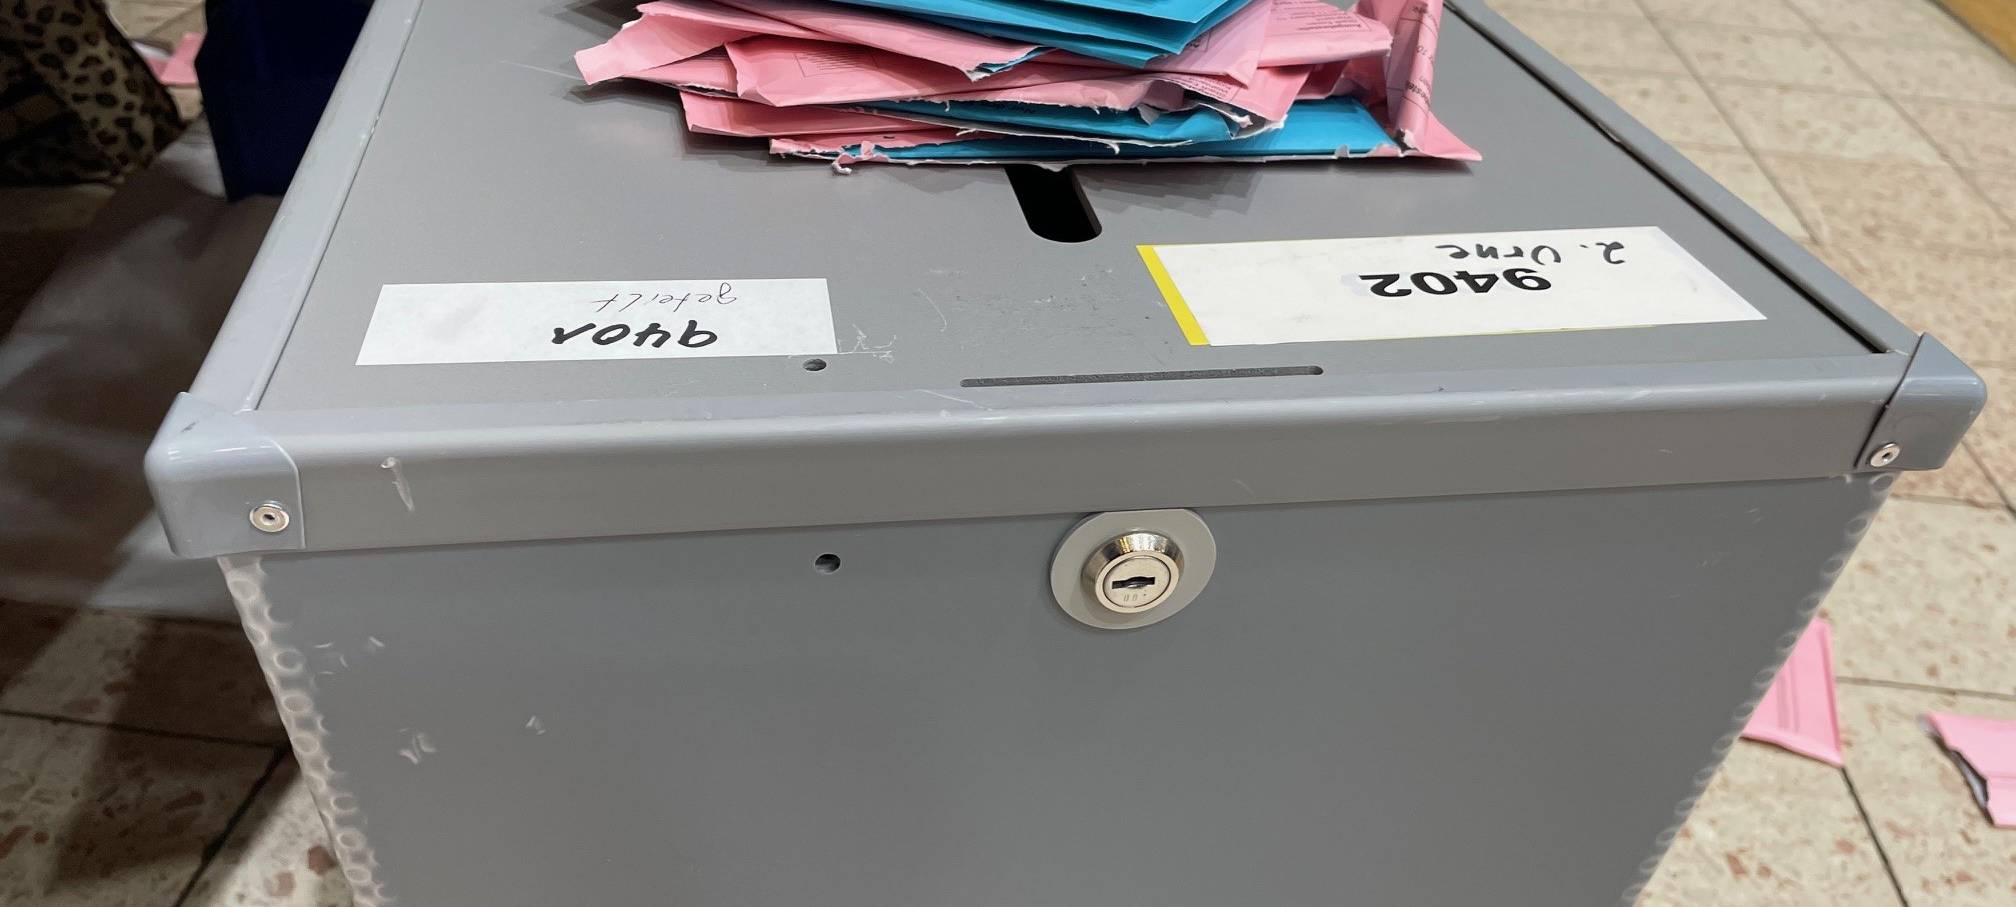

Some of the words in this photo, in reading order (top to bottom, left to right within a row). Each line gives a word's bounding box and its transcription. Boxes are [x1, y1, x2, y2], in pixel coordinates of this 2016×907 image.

[1433, 243, 1562, 266] Urne
[1579, 241, 1626, 265] 2.
[591, 281, 737, 313] geteilt
[1359, 267, 1552, 298] 9402
[551, 319, 718, 348] 9401
